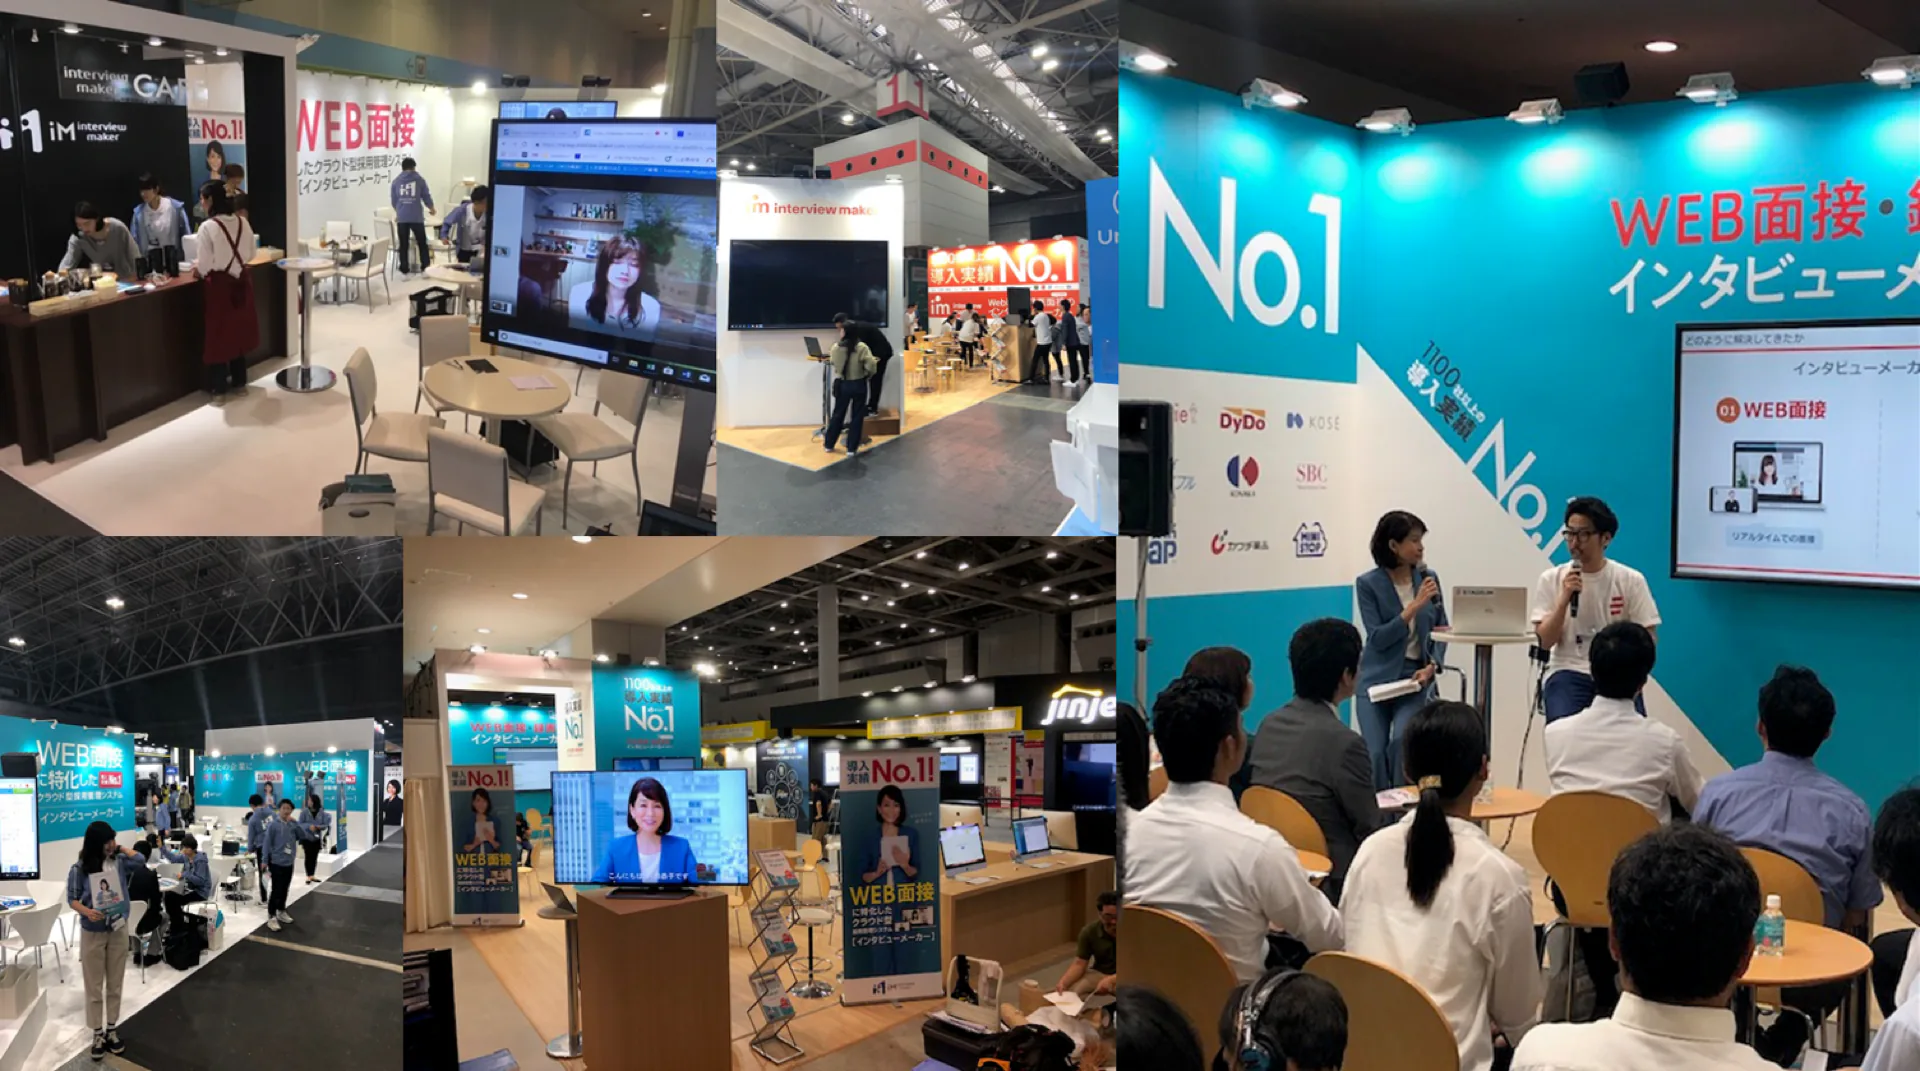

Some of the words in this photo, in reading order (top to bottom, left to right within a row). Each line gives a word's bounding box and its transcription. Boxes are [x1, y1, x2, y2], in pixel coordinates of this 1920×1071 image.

[76, 83, 116, 94] make
[77, 122, 127, 132] interview
[201, 118, 243, 140] No.1!
[296, 98, 415, 152] WEB面接
[86, 133, 119, 141] maker
[774, 203, 837, 215] interview
[1609, 178, 1920, 249] WEB面接・
[1147, 155, 1342, 335] No.1
[1000, 243, 1075, 284] No.1
[930, 264, 994, 285] 導入実績
[1608, 251, 1920, 315] インタビューメ
[1684, 333, 1805, 347] どのように解決してきたか
[1792, 359, 1920, 376] インタビューメーカ
[1406, 358, 1477, 443] 導入実績
[1719, 404, 1737, 417] 01
[1743, 400, 1828, 420] WEB面接
[1219, 411, 1266, 434] DyDo
[1296, 463, 1328, 482] SBC
[624, 704, 675, 733] No.1
[36, 739, 123, 769] WEB面接
[847, 760, 870, 772] 導入
[871, 756, 934, 784] No.1!
[467, 769, 509, 787] No.1!
[847, 772, 870, 785] 実績
[455, 853, 512, 867] WEB面接
[849, 881, 935, 906] WEB面接
